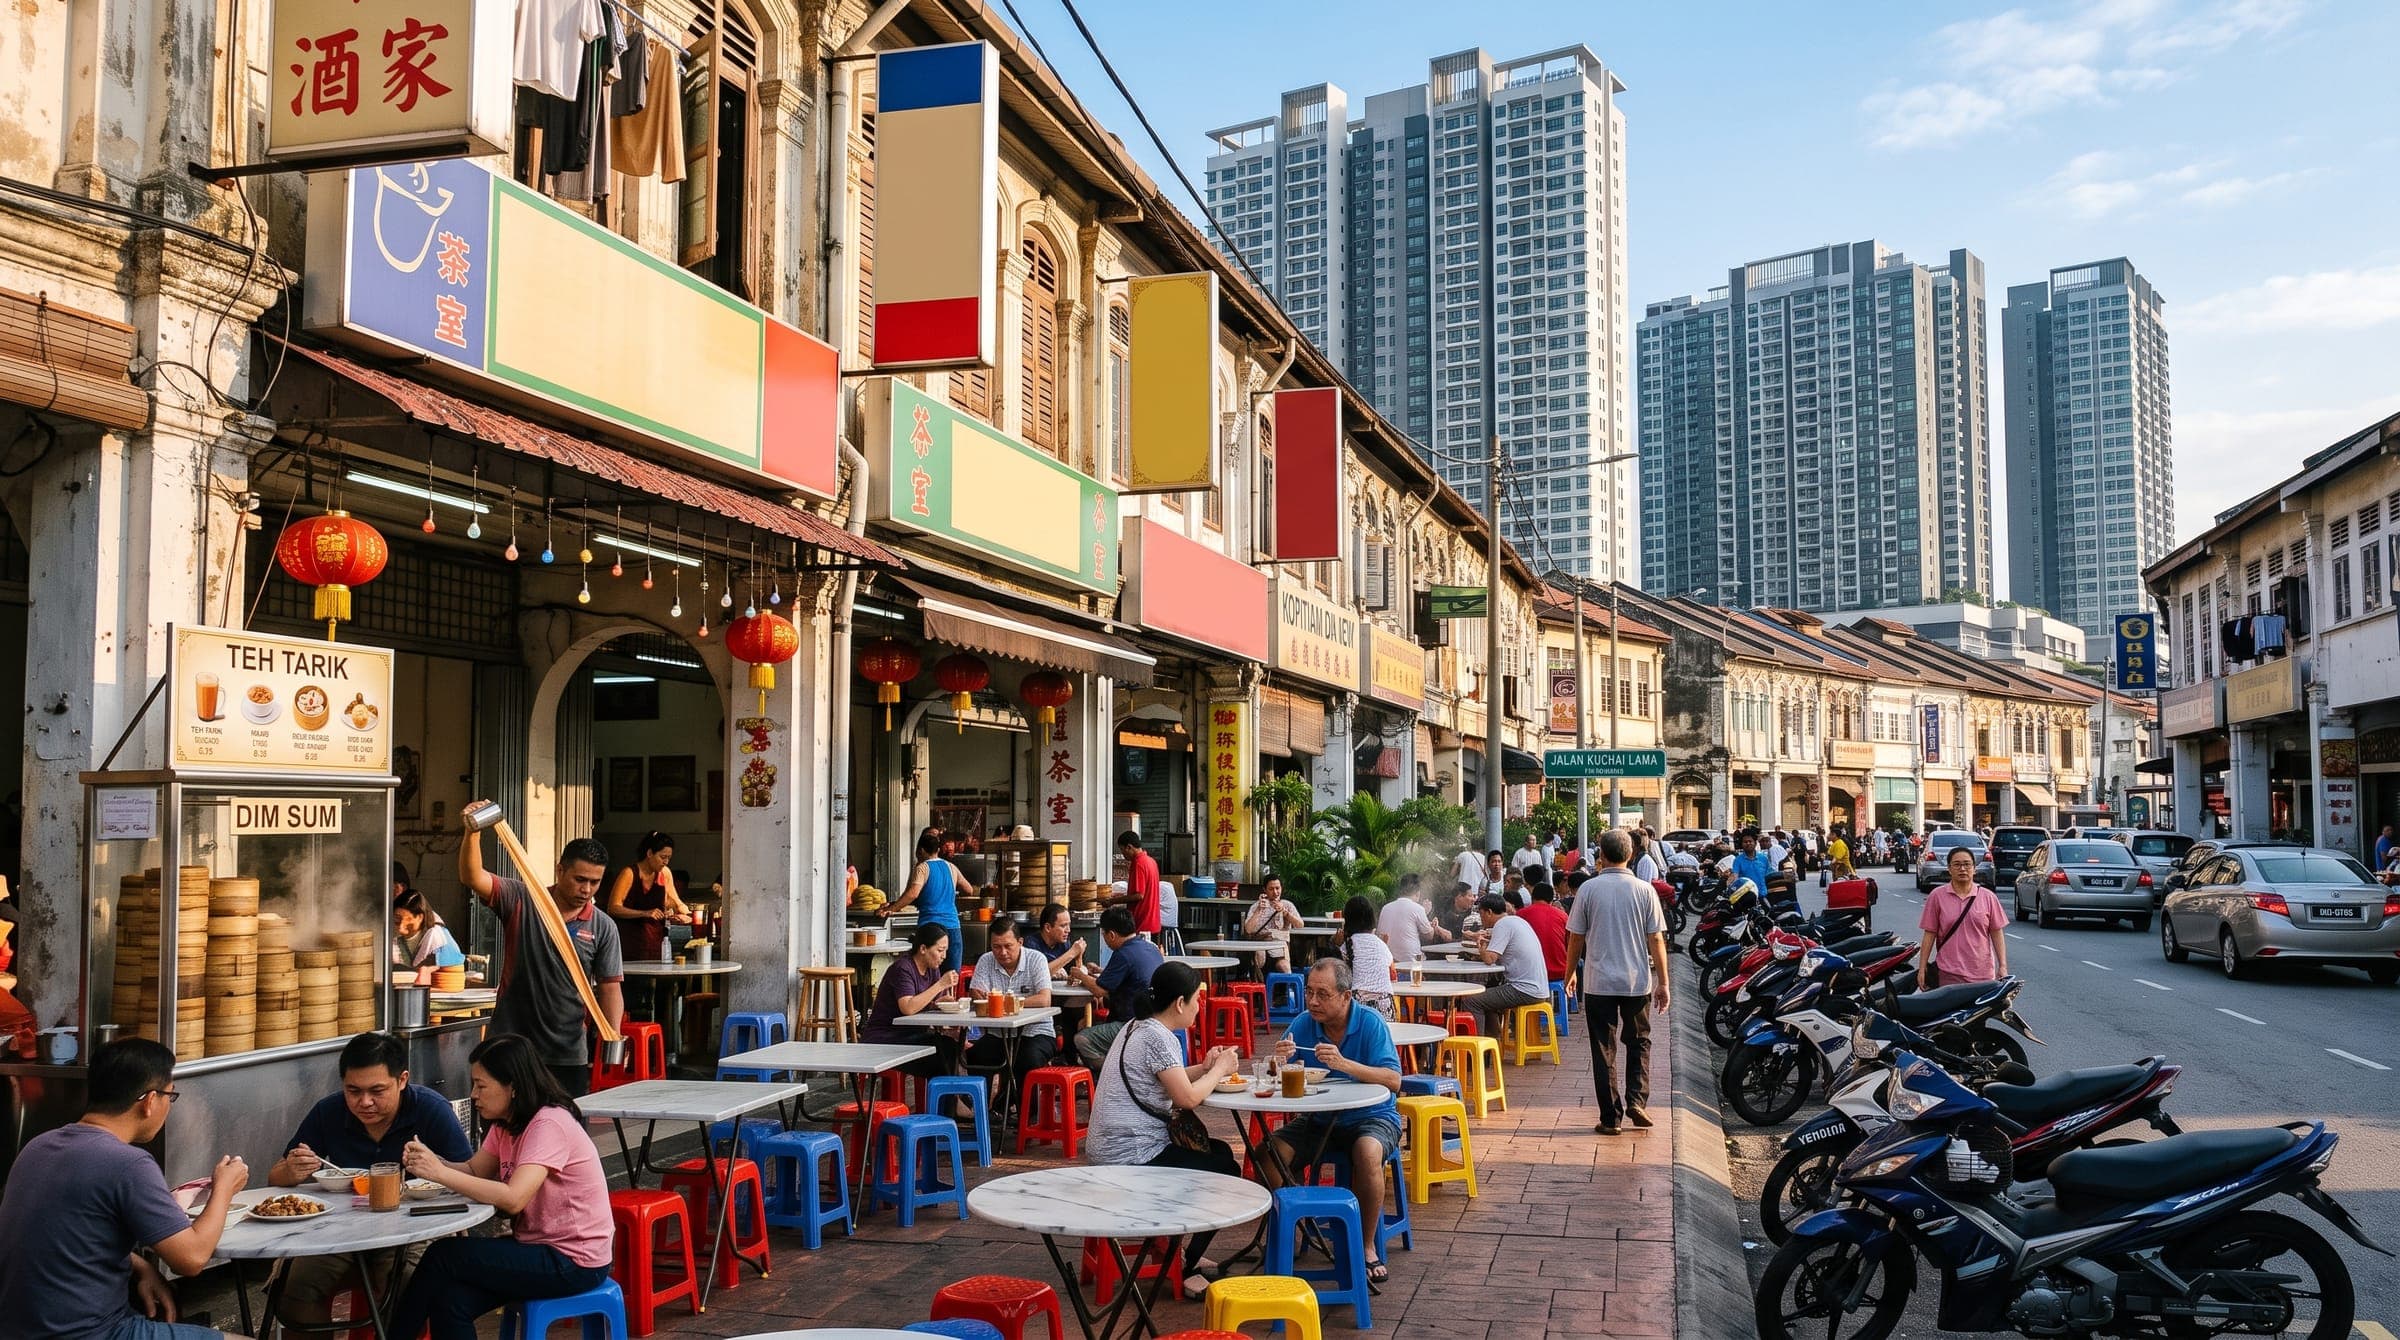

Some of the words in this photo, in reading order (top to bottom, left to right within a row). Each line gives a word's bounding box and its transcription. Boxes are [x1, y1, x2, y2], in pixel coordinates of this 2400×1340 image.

[290, 17, 453, 117] 酒家
[435, 231, 470, 348] 茶室
[910, 403, 933, 517] 茶室
[1093, 491, 1107, 580] 茶室
[226, 644, 273, 673] TEH
[282, 650, 349, 680] TARIK
[1551, 754, 1584, 766] JALAN
[1587, 754, 1625, 766] KUCHAI
[1629, 754, 1658, 766] LAMA
[237, 805, 280, 828] DIM
[287, 805, 336, 828] SUM
